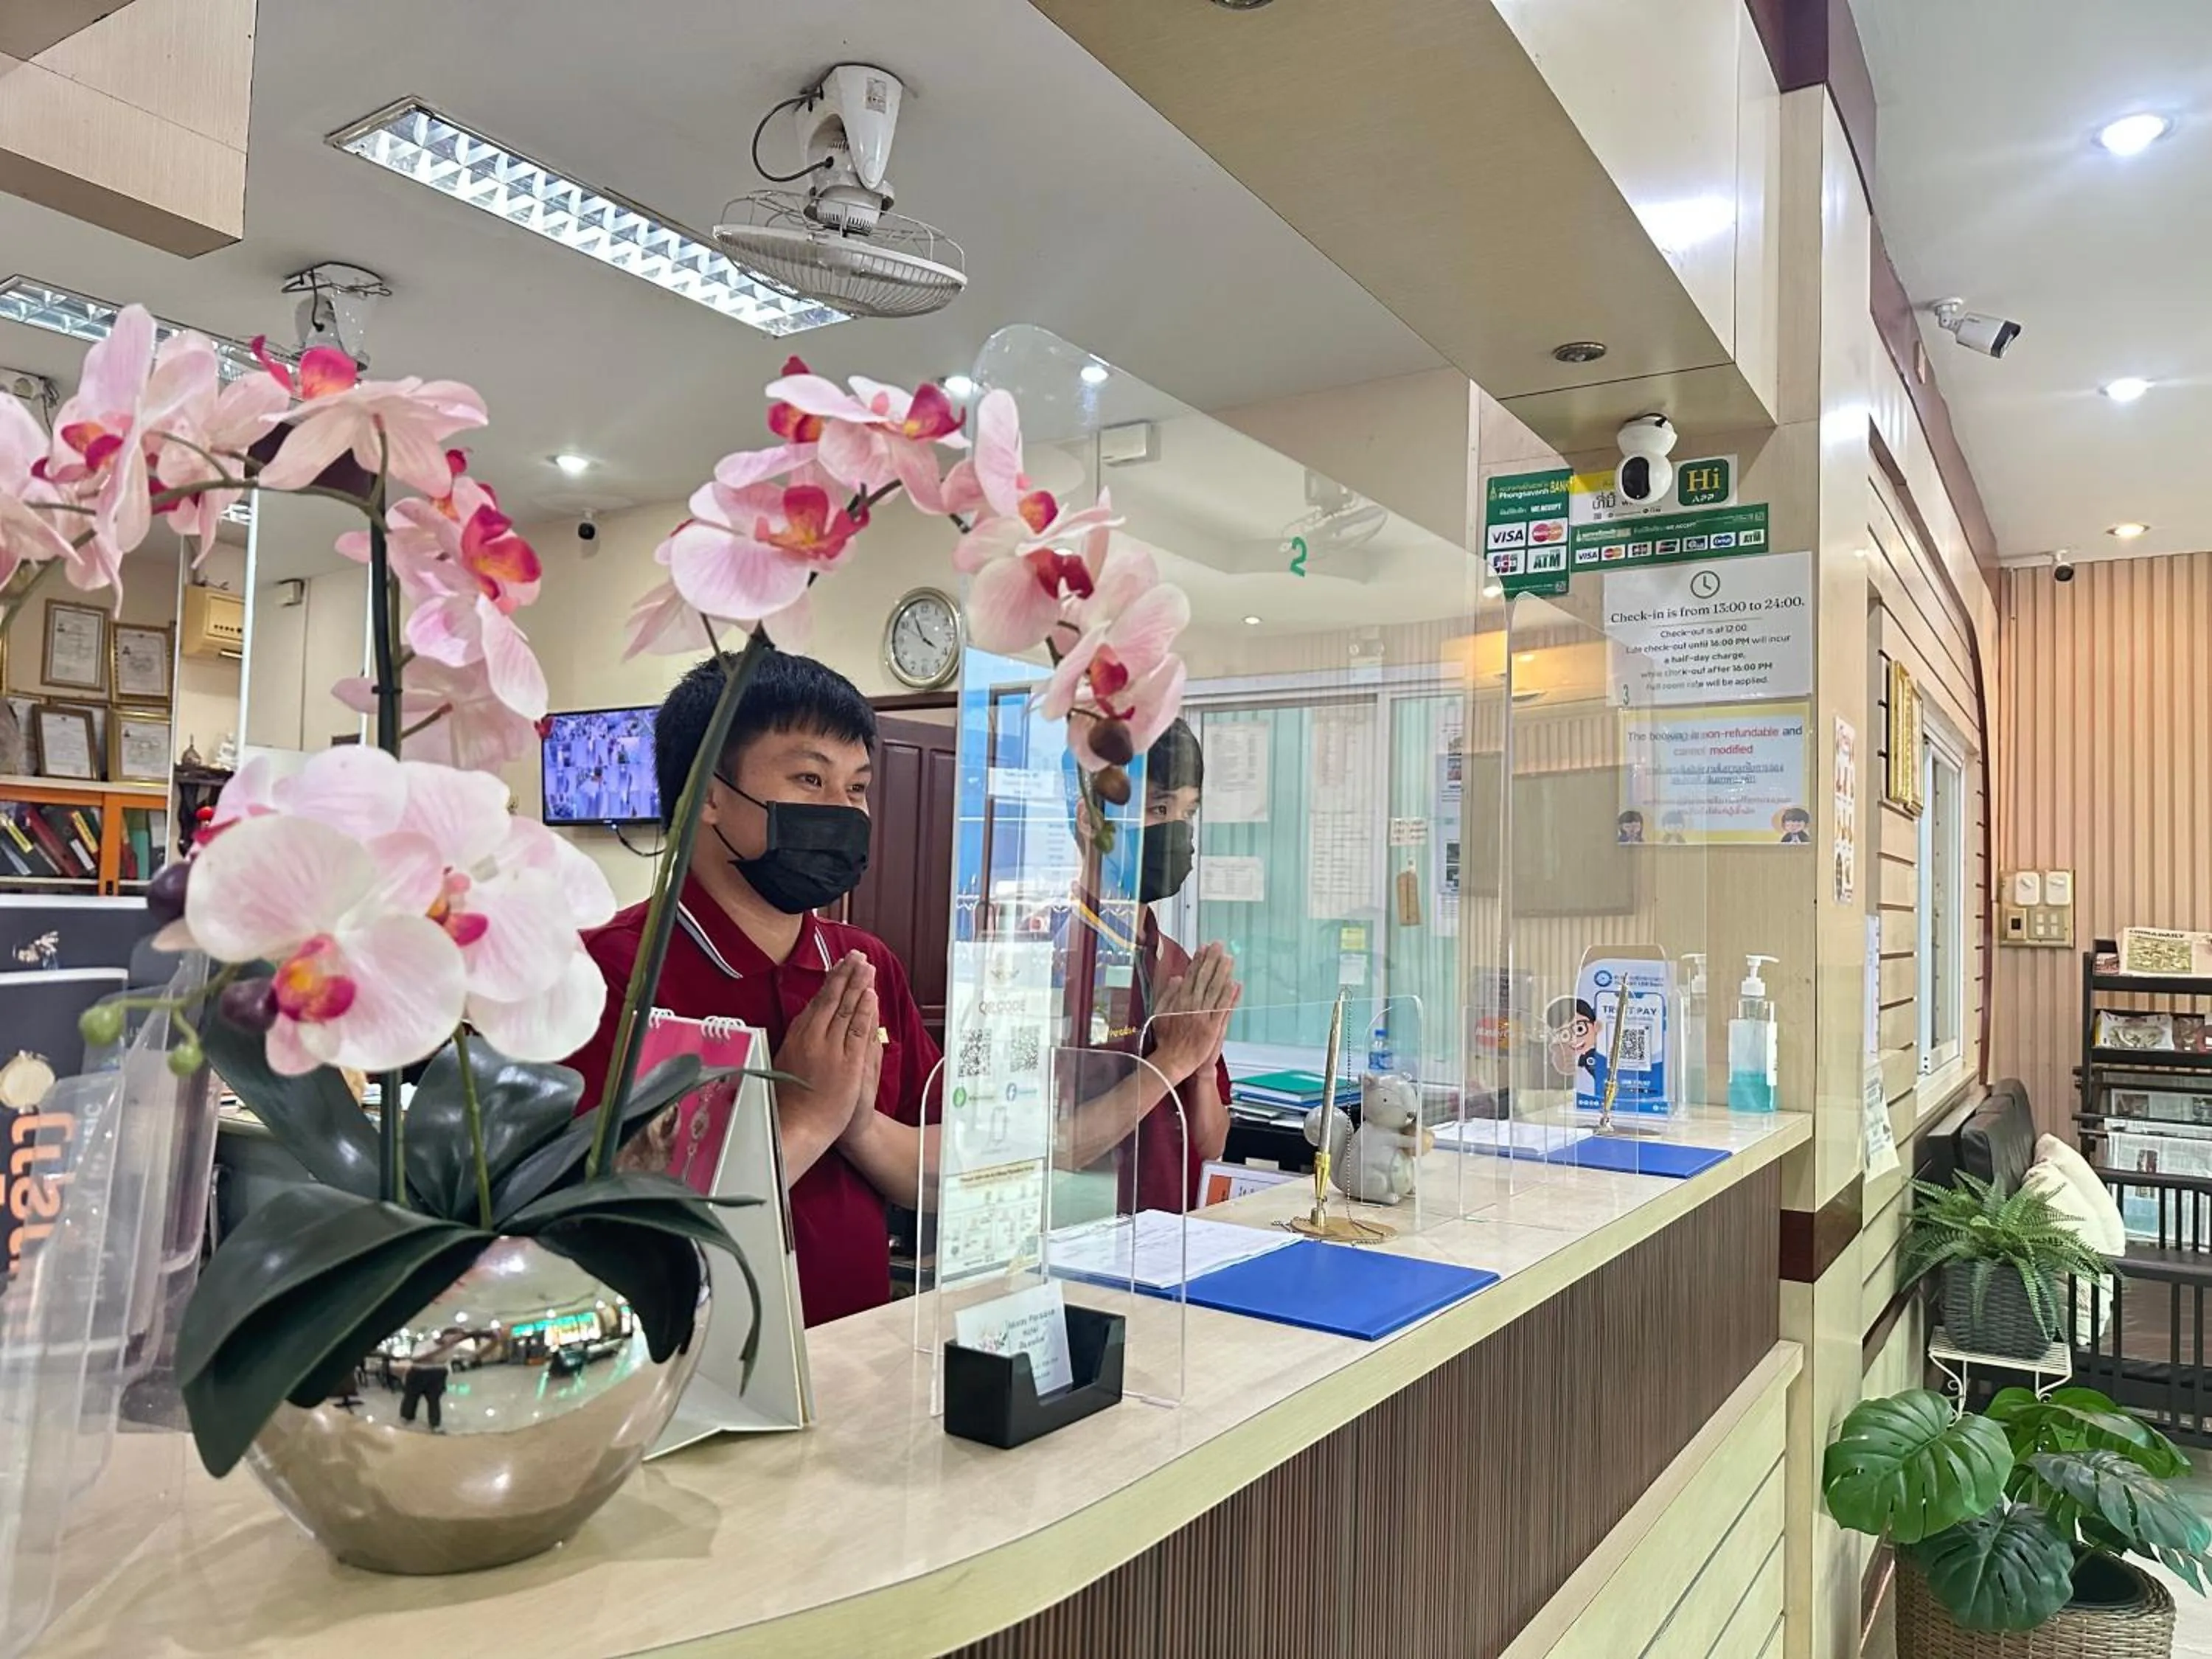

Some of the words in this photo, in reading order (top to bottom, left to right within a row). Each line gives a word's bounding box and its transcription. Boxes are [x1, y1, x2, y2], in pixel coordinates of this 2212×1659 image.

[1687, 467, 1719, 492] Hi
[1492, 529, 1524, 543] VISA
[1290, 536, 1307, 578] 2
[1534, 551, 1561, 568] ATM
[1579, 552, 1598, 560] VISA
[1611, 609, 1663, 623] Check-in
[1667, 608, 1677, 618] is
[1680, 605, 1710, 617] from
[1750, 601, 1761, 611] to
[1660, 628, 1705, 639] Check-out
[1716, 626, 1724, 634] at
[1644, 641, 1687, 653] check-out
[1688, 639, 1709, 650] until
[1736, 636, 1750, 645] PM
[1752, 636, 1767, 644] will
[1769, 635, 1791, 643] incur
[1672, 654, 1710, 663] half-day
[1758, 661, 1773, 670] PM
[1706, 678, 1720, 687] will
[1722, 678, 1733, 686] be
[1628, 731, 1646, 742] The
[1702, 726, 1779, 740] non-refundable
[1782, 726, 1803, 736] and
[1710, 744, 1754, 756] modified
[1602, 1005, 1635, 1015] TRT
[1637, 1007, 1658, 1015] PAY
